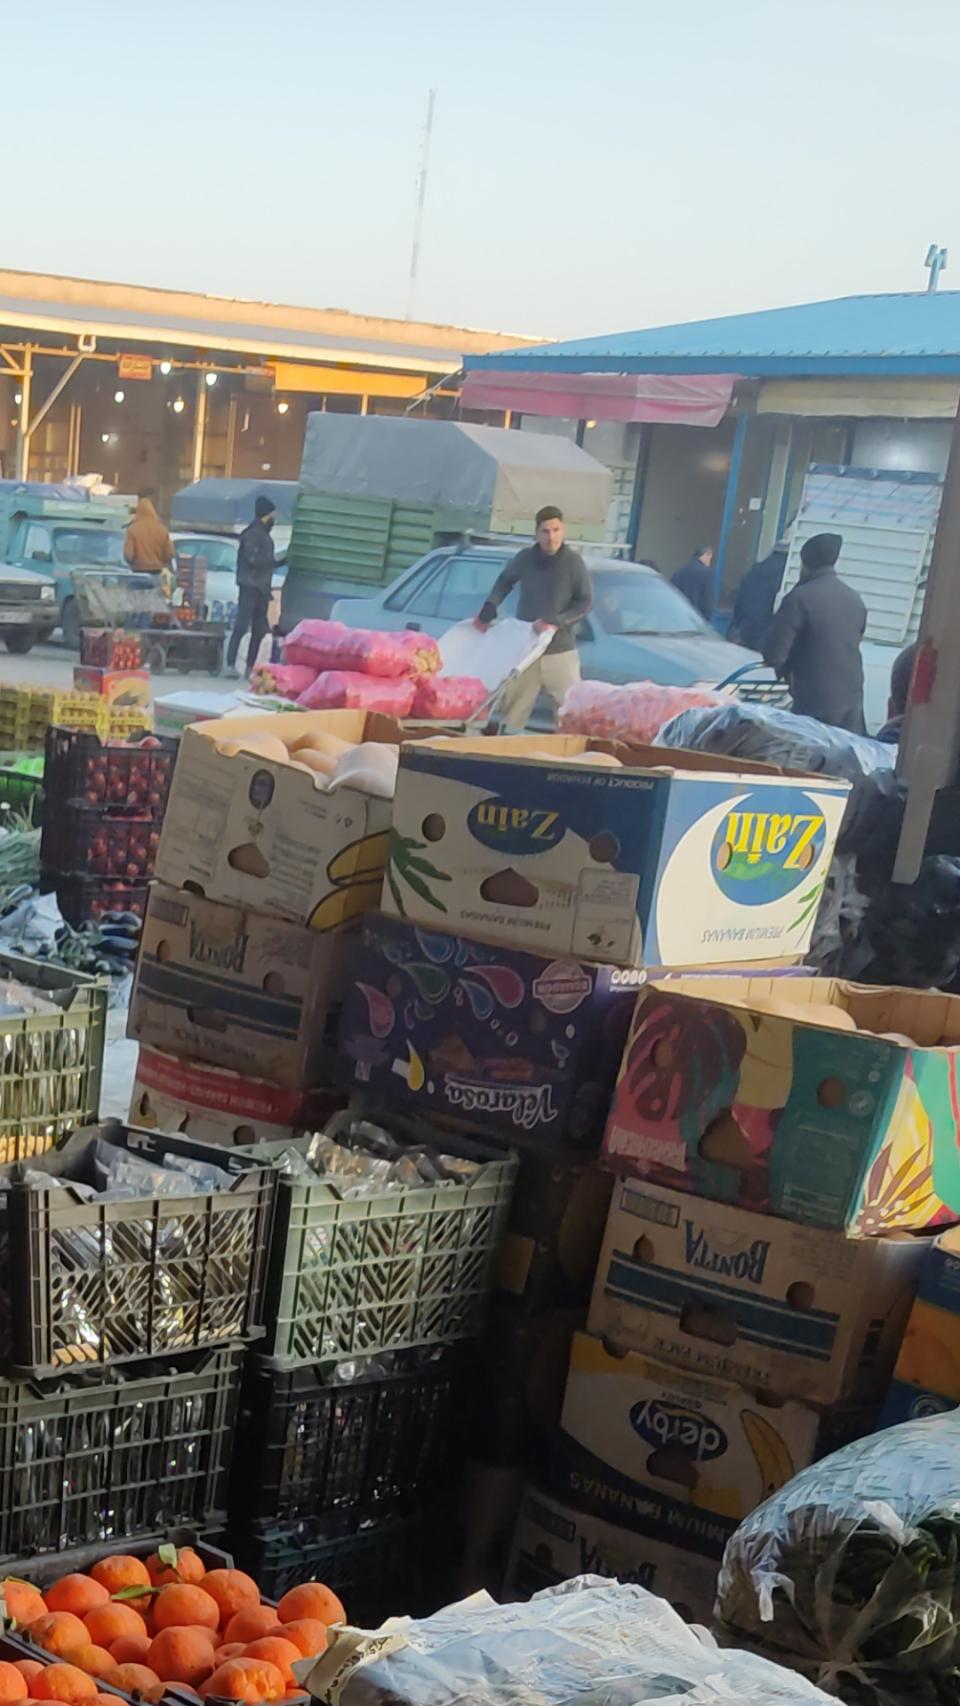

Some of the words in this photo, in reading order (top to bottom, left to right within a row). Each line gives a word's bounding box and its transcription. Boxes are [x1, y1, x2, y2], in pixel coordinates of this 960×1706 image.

[478, 804, 559, 840] Zain
[724, 812, 824, 869] Zain
[189, 921, 249, 974] BONITA
[701, 929, 746, 944] BANANAS
[746, 926, 783, 940] PREMIUM
[684, 1221, 771, 1285] BONITA
[636, 1399, 720, 1461] derby
